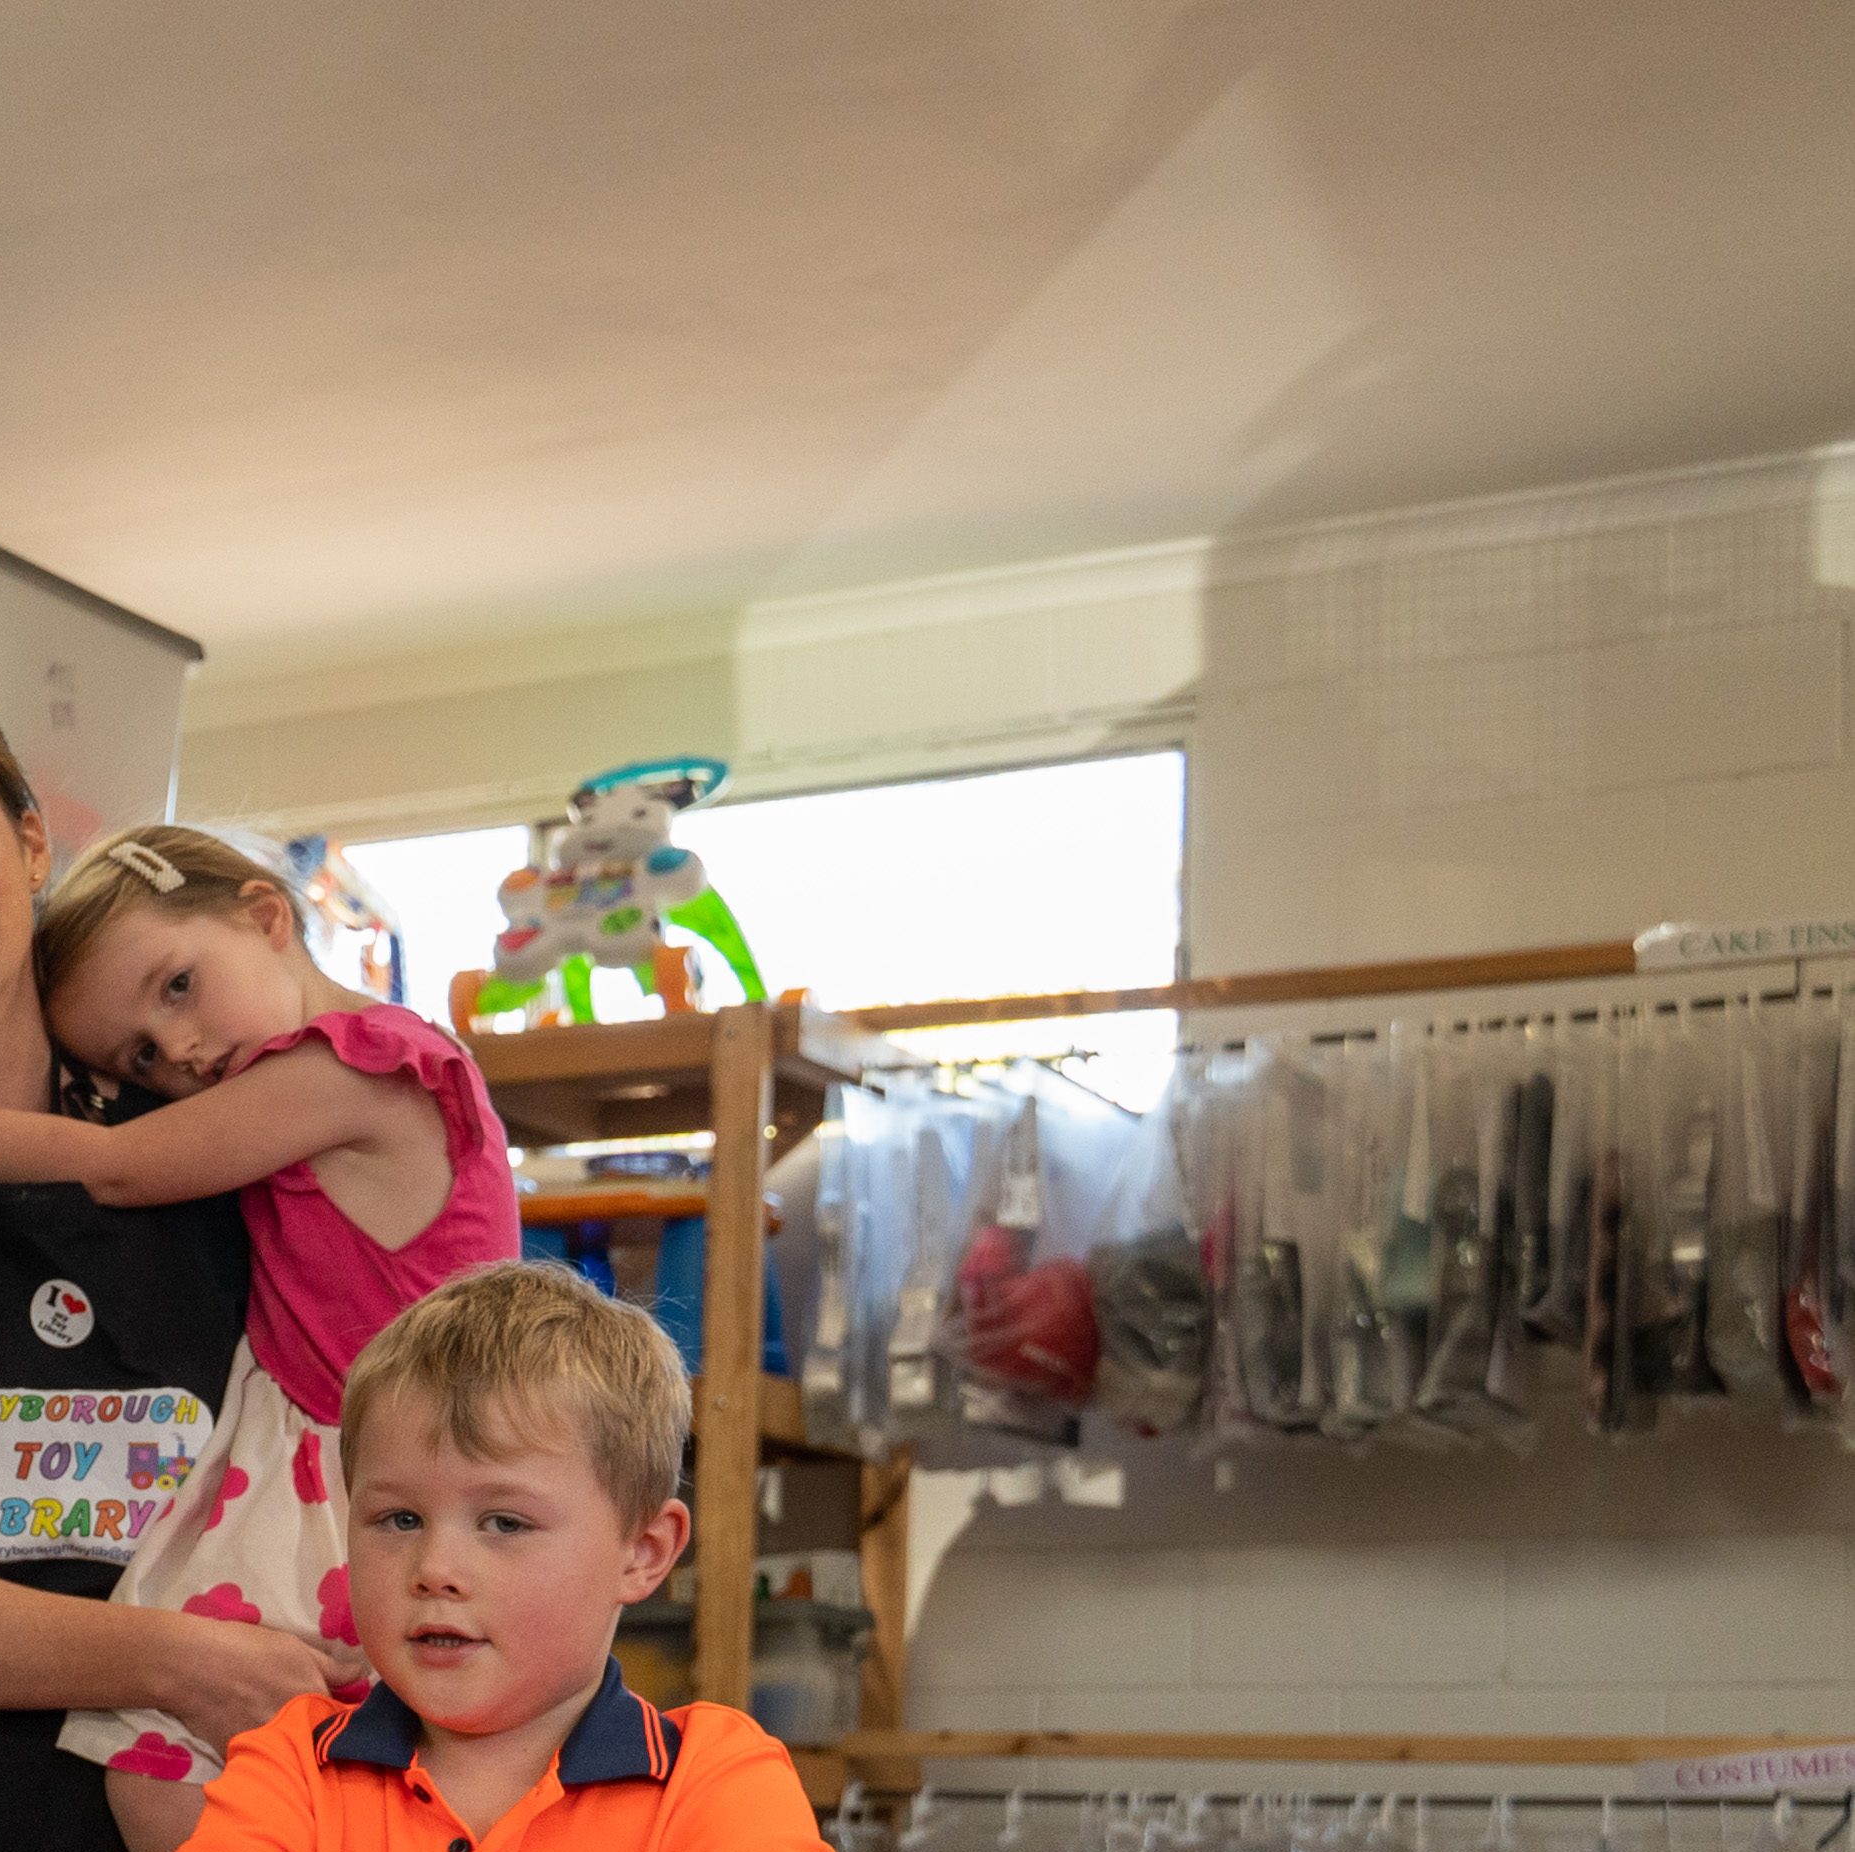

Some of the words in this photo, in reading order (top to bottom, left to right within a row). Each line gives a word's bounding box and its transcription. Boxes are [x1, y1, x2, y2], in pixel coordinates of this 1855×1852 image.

[1678, 928, 1774, 959] CAKE
[46, 1284, 61, 1307] I
[37, 1320, 73, 1344] Library
[14, 1440, 103, 1481] TOY
